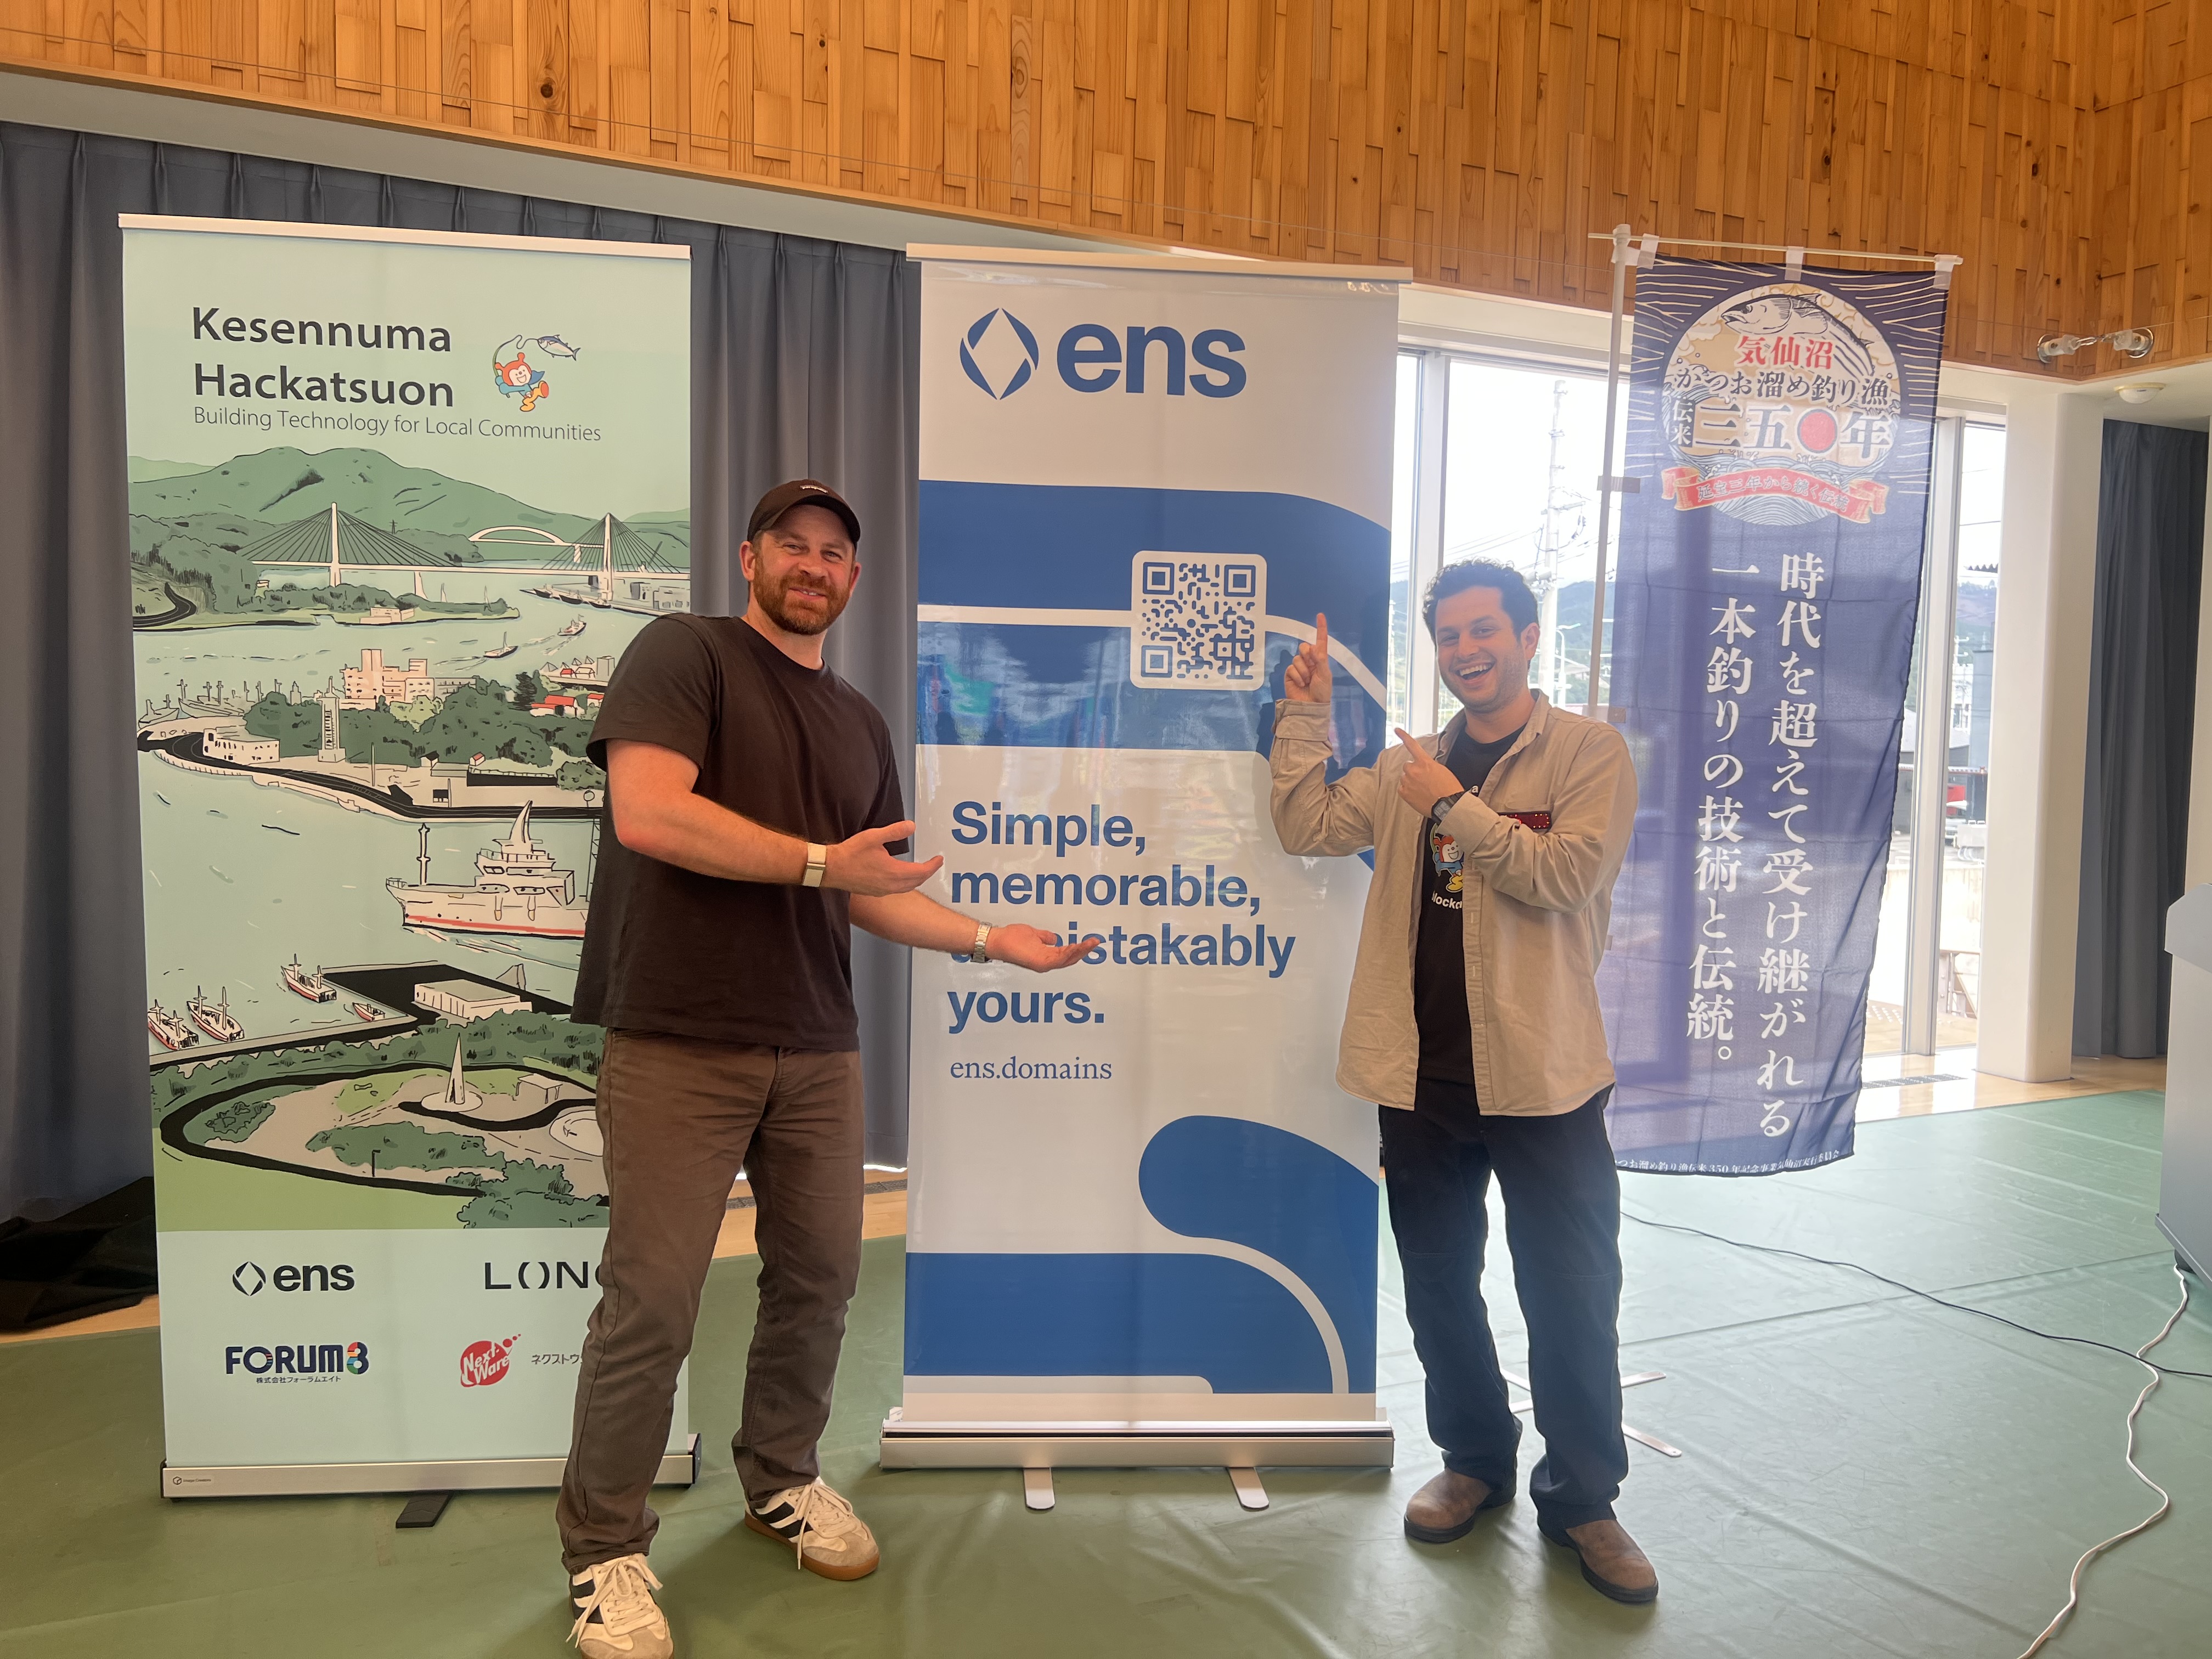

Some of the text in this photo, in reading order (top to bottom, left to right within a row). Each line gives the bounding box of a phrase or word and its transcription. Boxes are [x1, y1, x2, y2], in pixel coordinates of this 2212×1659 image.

[193, 307, 451, 352] Kesennuma
[1056, 324, 1247, 398] ens
[1737, 335, 1833, 370] 気仙沼
[195, 363, 454, 407] Hackatsuon
[1677, 371, 1889, 406] かつお溜め釣り漁
[194, 407, 601, 441] Building Technology for Local Communities
[1697, 475, 1849, 512] 延宝三年から続く伝統
[951, 801, 1146, 857] Simple,
[1687, 565, 1760, 1060] 一本釣りの技術と伝統。
[1757, 552, 1824, 1137] 時代を超えて受け継がれる
[951, 864, 1260, 917] memorable,
[947, 991, 1105, 1035] yours.
[950, 1056, 1113, 1080] ens.domains
[274, 1264, 355, 1292] ens
[485, 1261, 603, 1289] LON
[225, 1341, 369, 1375] FORUM8
[474, 1356, 510, 1384] Ware
[256, 1375, 342, 1384] 株式会社フォーラムエイト
